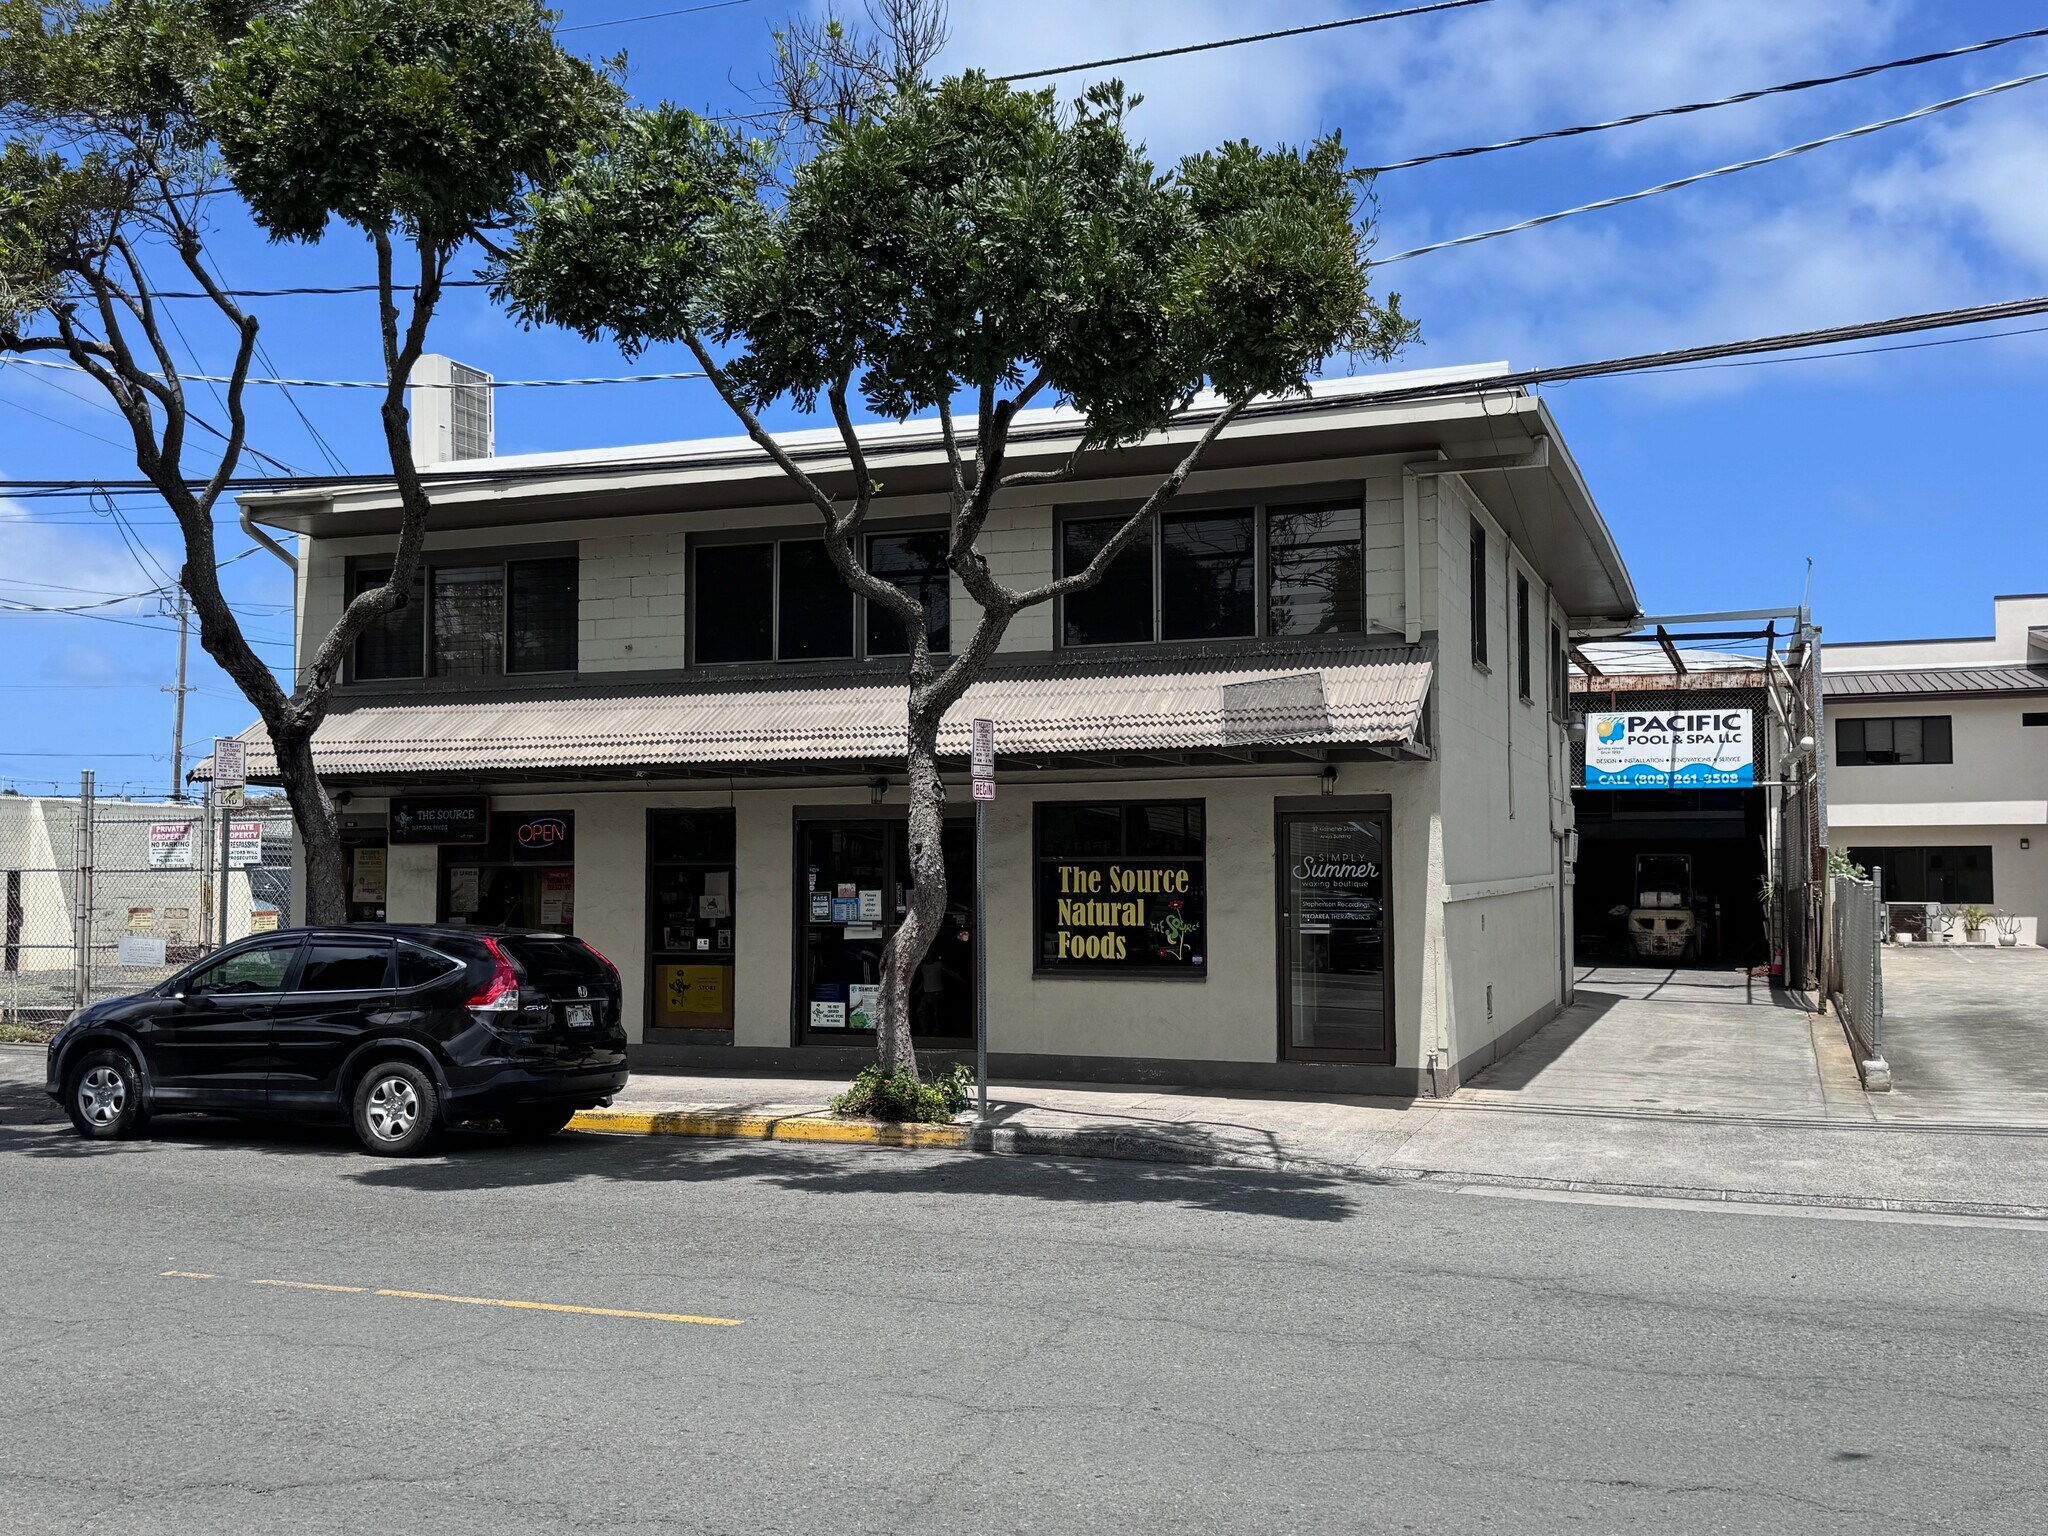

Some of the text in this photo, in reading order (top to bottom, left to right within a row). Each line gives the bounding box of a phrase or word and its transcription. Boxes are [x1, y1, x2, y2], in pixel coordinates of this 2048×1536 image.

[1628, 714, 1741, 732] PACIFIC
[1628, 734, 1741, 745] POOL & SPA LLC
[1599, 773, 1738, 786] CALL (808) 261-3508
[976, 784, 993, 795] BEGIN
[417, 809, 475, 820] THE SOURCE
[518, 824, 565, 842] OPEN
[1318, 853, 1365, 862] SIMPLY
[1293, 856, 1379, 880] Summer
[1058, 865, 1189, 894] The Source
[1302, 880, 1369, 889] waxing boutique
[1302, 901, 1370, 909] Stephenson Recordings
[1057, 899, 1145, 927] Natural
[1150, 921, 1165, 933] THE
[1057, 931, 1127, 960] Foods
